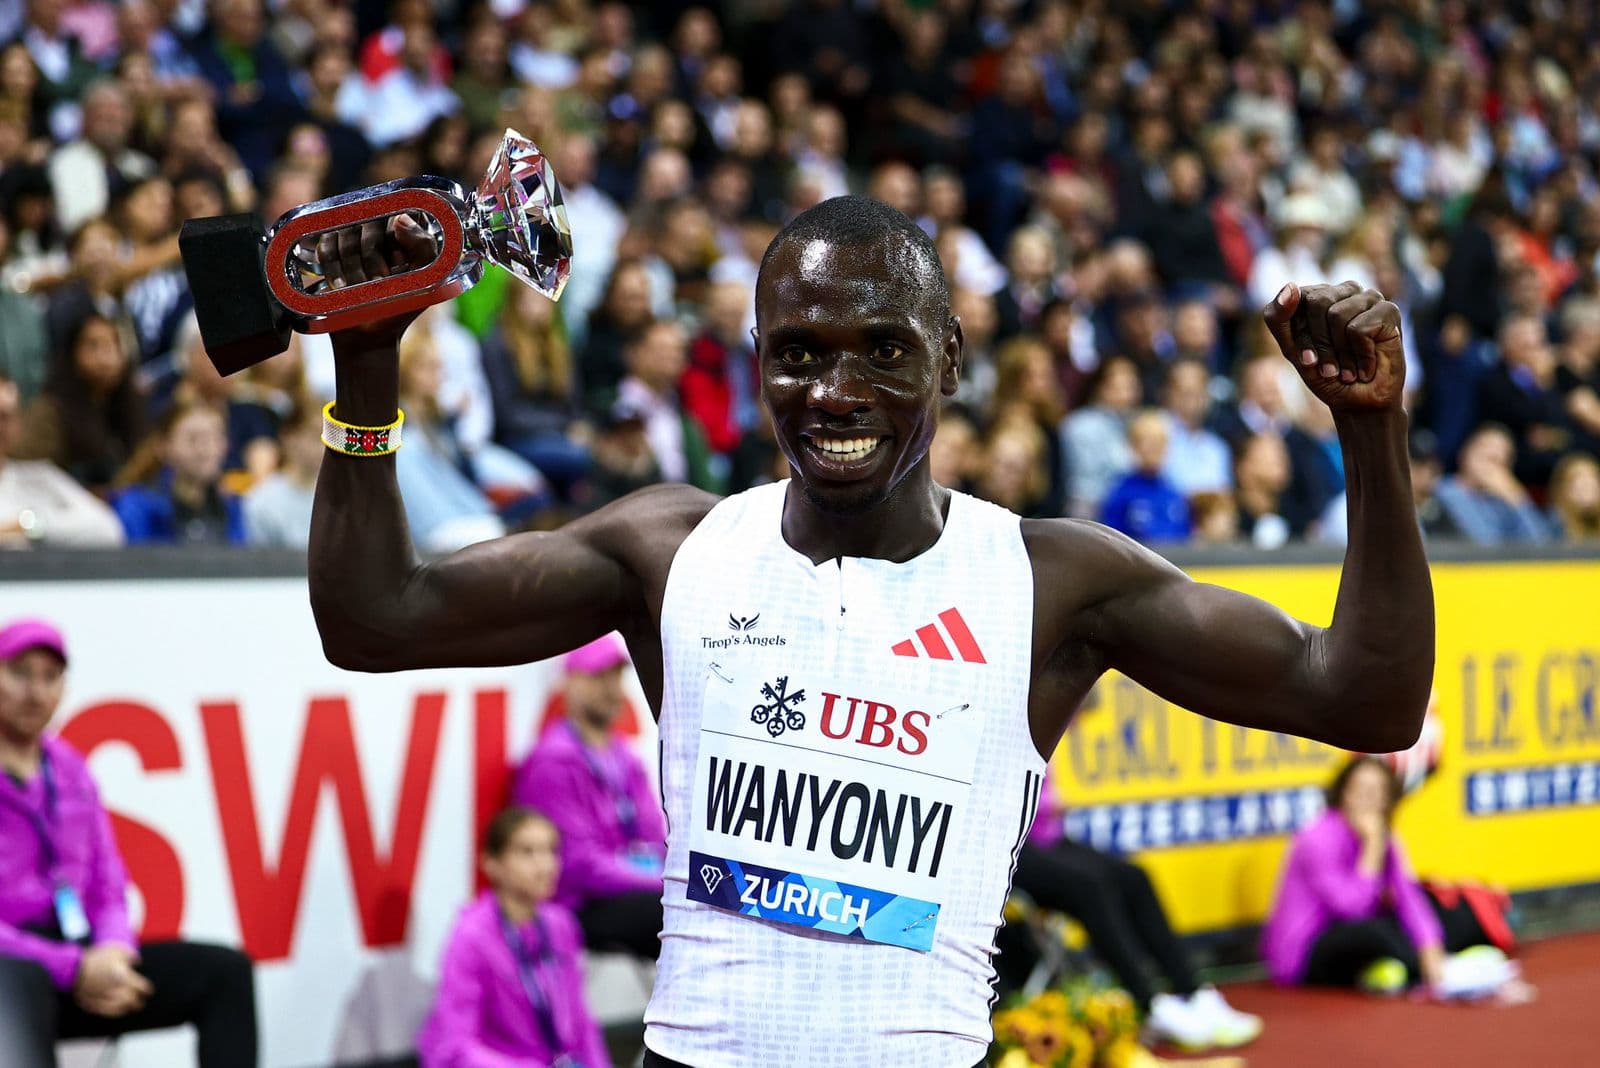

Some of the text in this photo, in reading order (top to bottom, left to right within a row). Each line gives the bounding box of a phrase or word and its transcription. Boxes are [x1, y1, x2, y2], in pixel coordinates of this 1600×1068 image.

[700, 634, 786, 649] Tirop's Angels
[819, 691, 931, 756] UBS
[57, 682, 642, 964] SWI
[706, 756, 953, 878] WANYONYI
[740, 874, 869, 927] ZURICH
